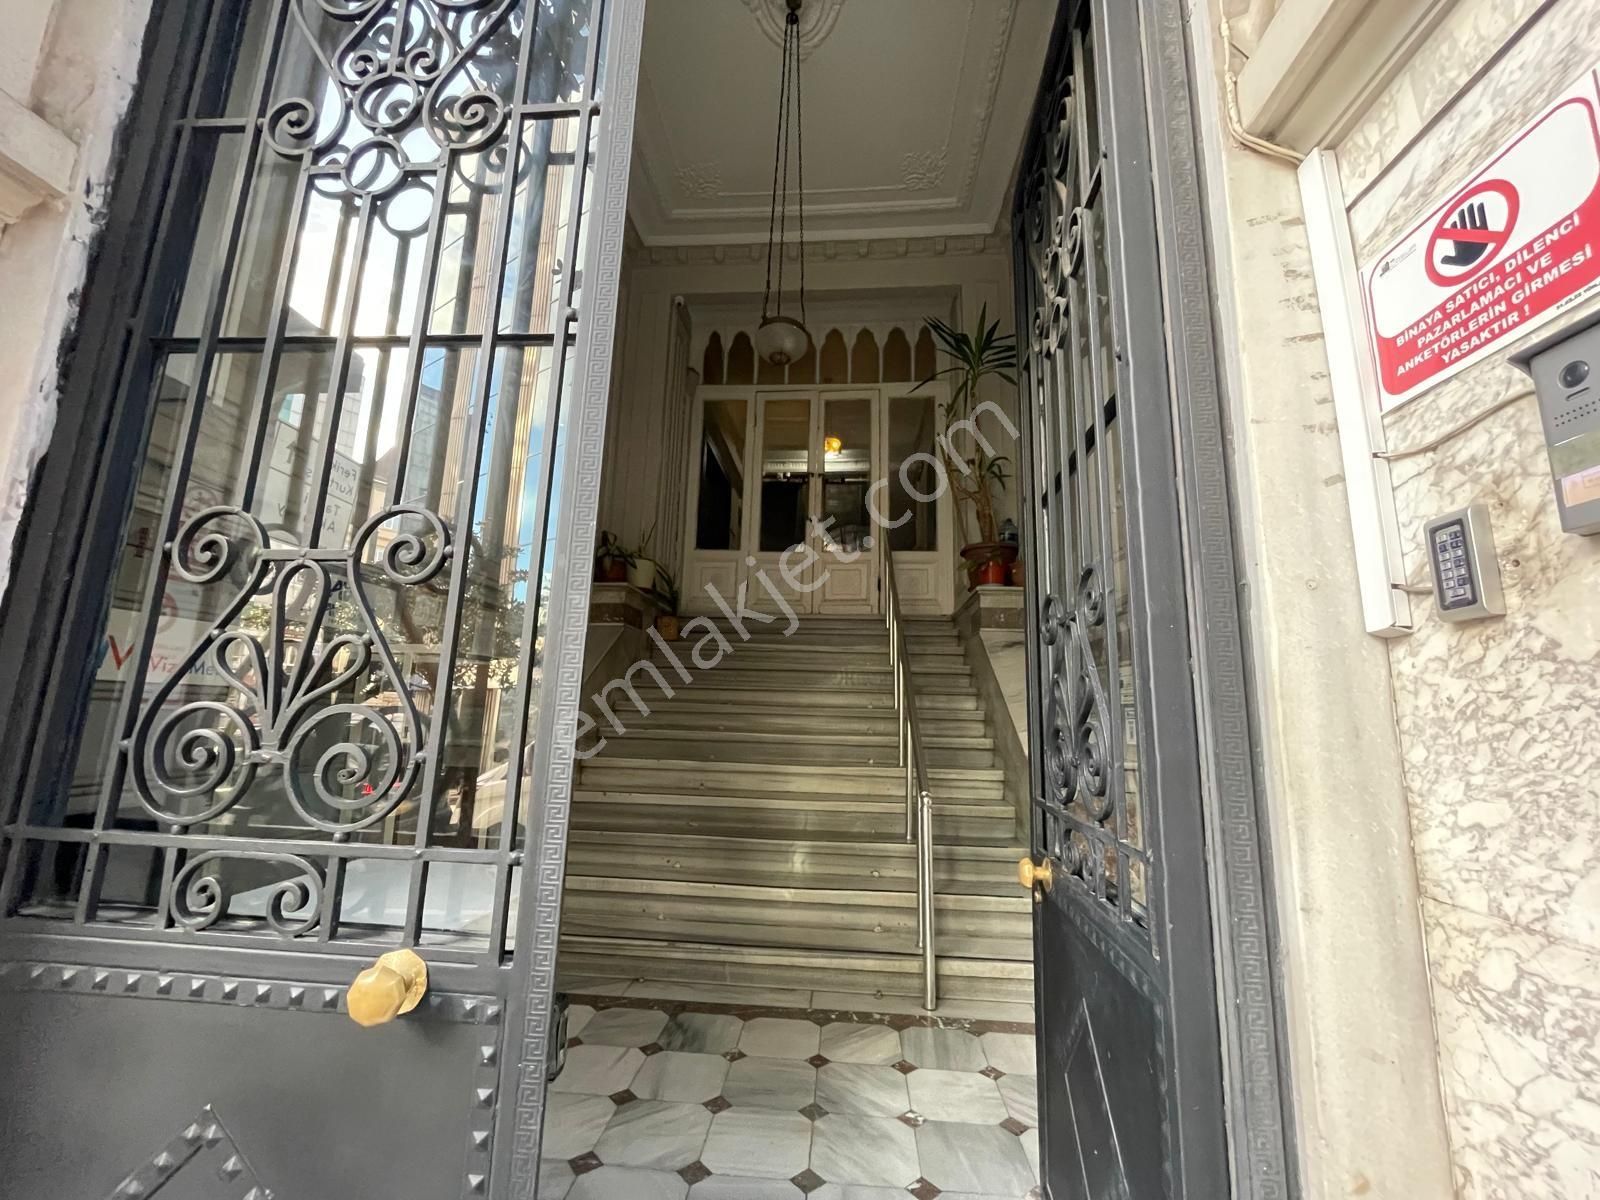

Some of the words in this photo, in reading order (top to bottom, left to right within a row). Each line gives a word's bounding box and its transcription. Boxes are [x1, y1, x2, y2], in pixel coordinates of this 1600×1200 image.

[1396, 310, 1443, 347] BİNAYA
[1445, 272, 1501, 313] SATICI,
[1504, 211, 1580, 273] DİLENCİ
[1397, 300, 1507, 377] ANKETÖRLERİN
[1511, 243, 1593, 304] GİRMESİ
[1417, 271, 1522, 348] PAZARLAMACI
[1526, 252, 1552, 275] VE
[1441, 311, 1520, 364] YASAKTIR
